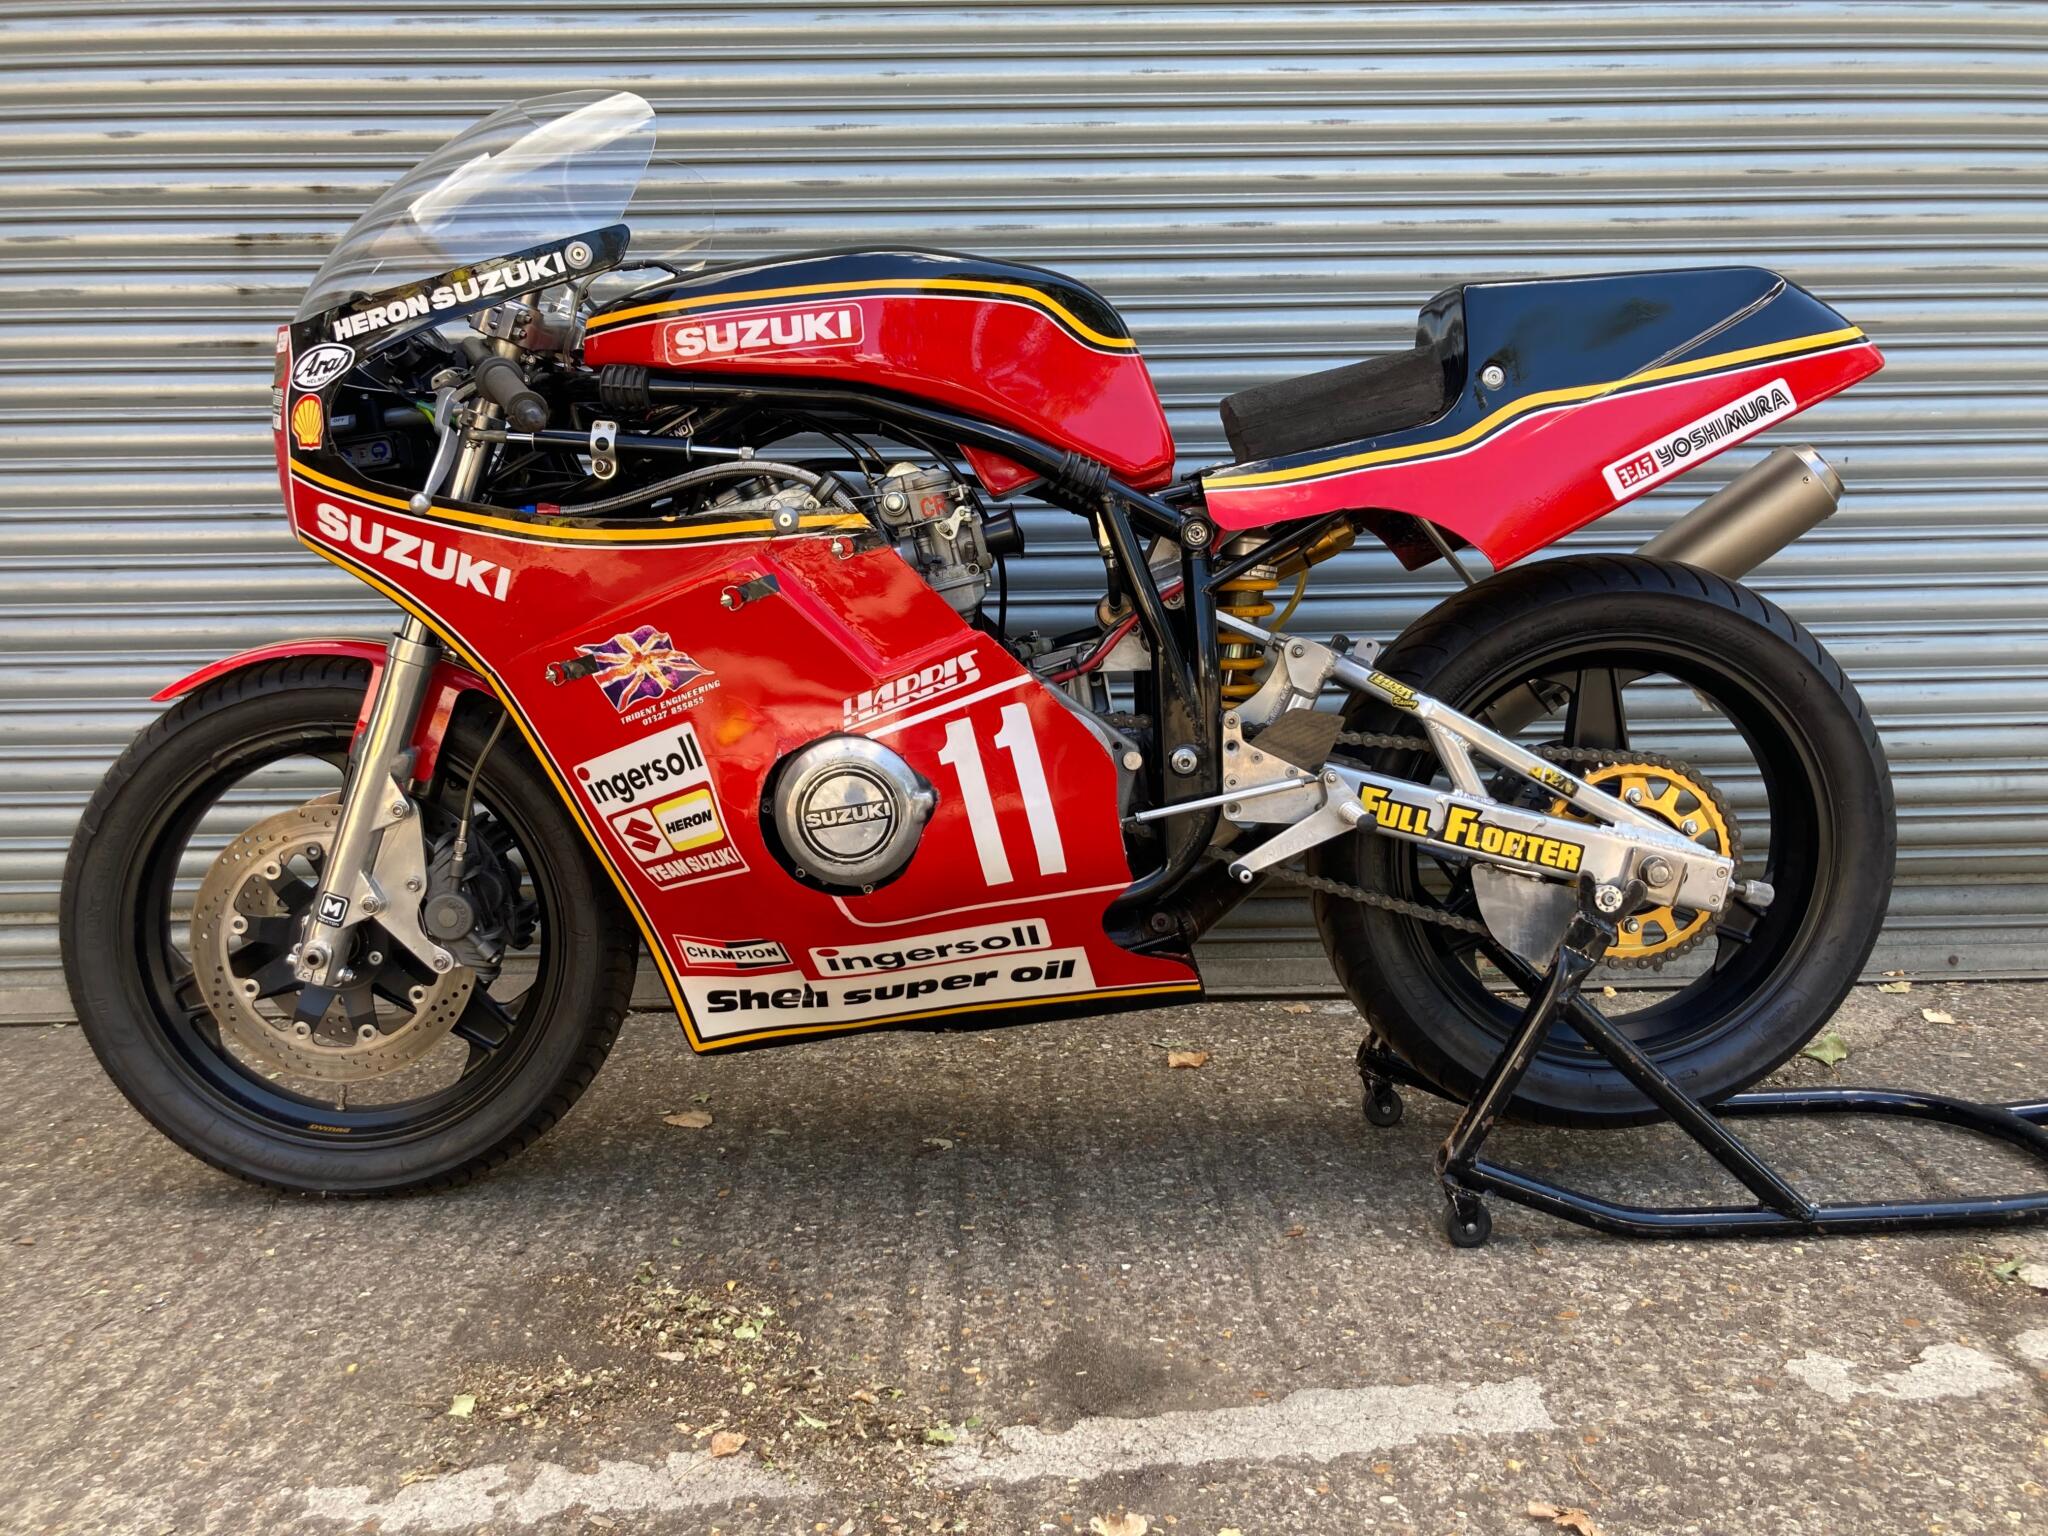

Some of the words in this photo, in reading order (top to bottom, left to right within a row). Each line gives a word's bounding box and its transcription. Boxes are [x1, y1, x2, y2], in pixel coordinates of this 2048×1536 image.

[332, 295, 430, 342] HERON
[429, 250, 567, 311] SUZUKI
[674, 310, 853, 357] SUZUKI
[294, 350, 350, 379] Arai
[1655, 388, 1790, 468] YOSHIMURA
[919, 496, 948, 518] CR
[316, 502, 512, 603] SUZUKI
[620, 704, 657, 725] TRIDENT
[659, 679, 721, 709] ENGINEERING
[642, 710, 668, 726] 01327
[671, 696, 705, 715] 855855
[576, 732, 704, 804] ingersoll
[805, 802, 891, 829] SUZUKI
[937, 702, 1067, 887] 11
[1360, 785, 1430, 836] FULL
[665, 808, 713, 835] HERON
[685, 945, 780, 962] CHAMPION
[815, 925, 1042, 972] ingersoll
[842, 969, 999, 1006] super
[1010, 959, 1077, 984] oil
